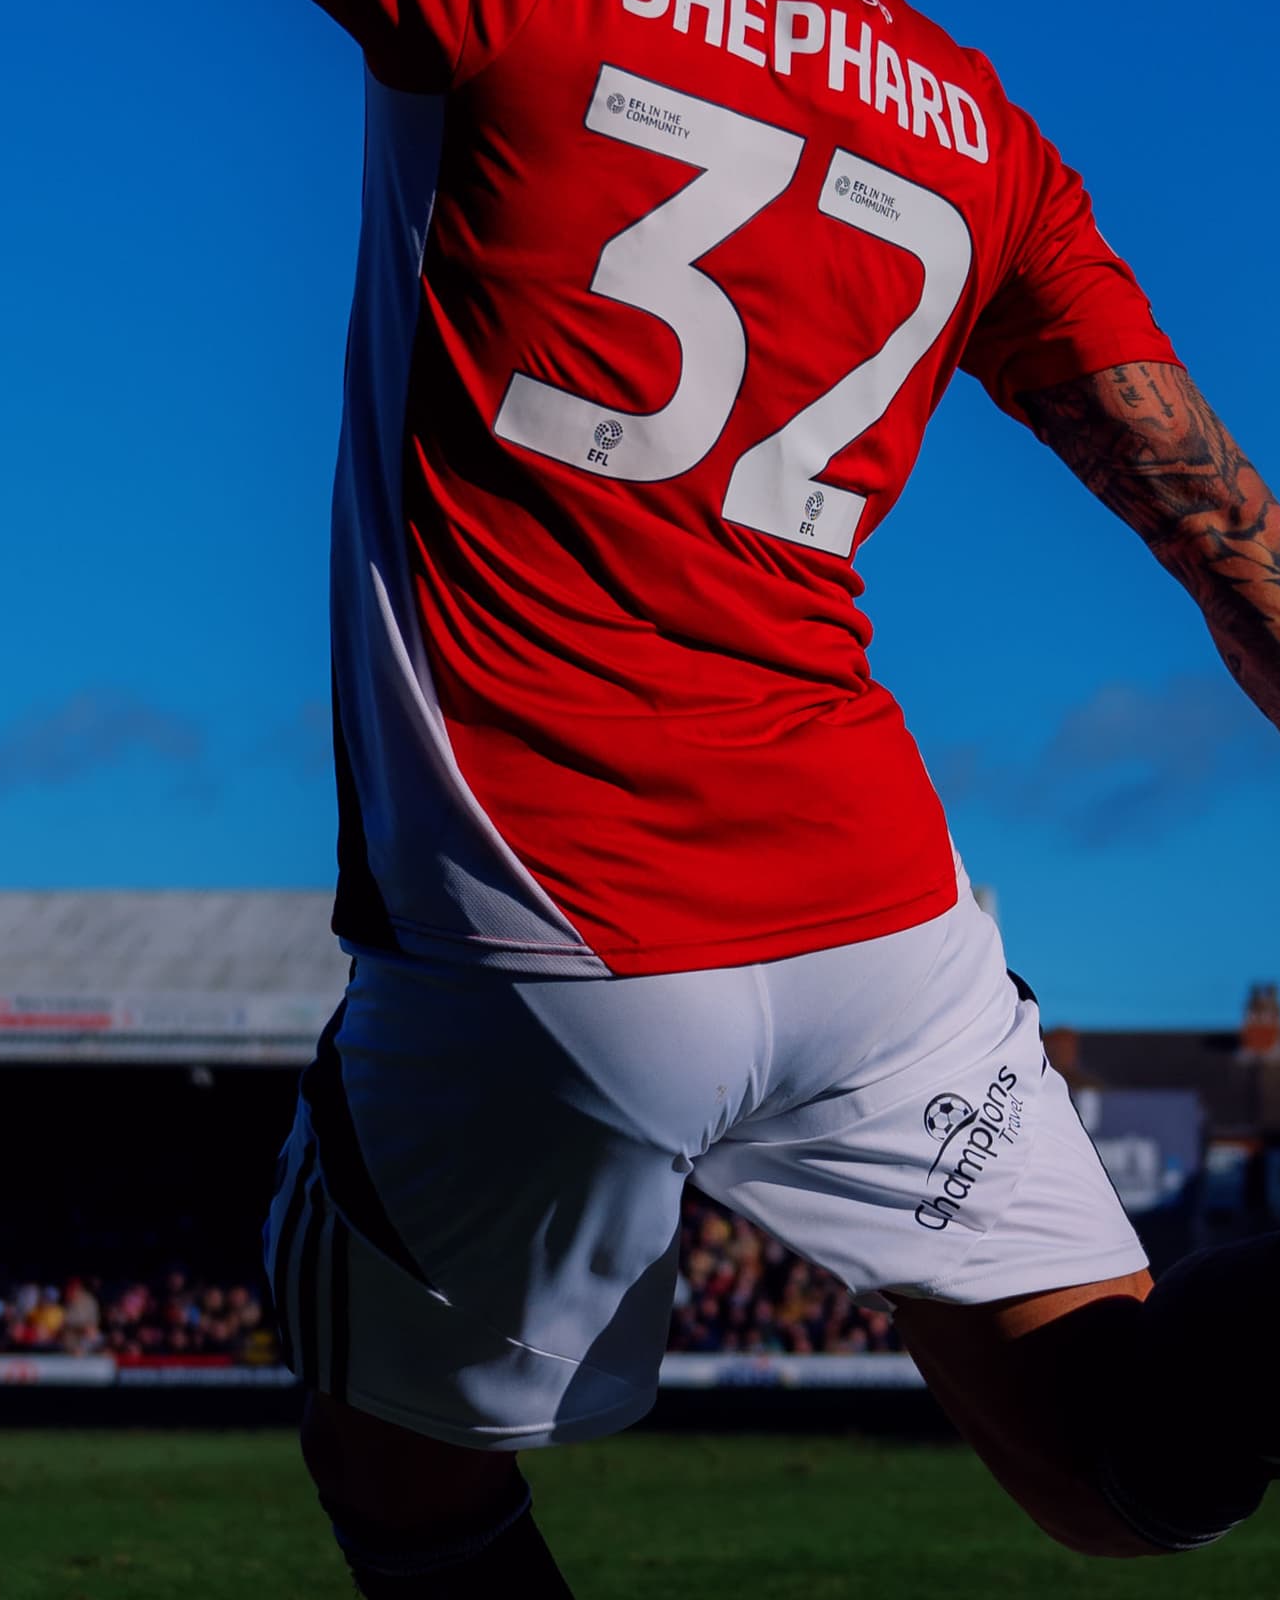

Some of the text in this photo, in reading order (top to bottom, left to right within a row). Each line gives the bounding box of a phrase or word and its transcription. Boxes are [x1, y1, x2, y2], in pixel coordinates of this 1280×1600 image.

[626, 109, 690, 139] COMMUNITY
[628, 98, 682, 125] EFL IN THE
[850, 191, 901, 221] COMMUNITY
[853, 180, 896, 208] EFL IN THE
[492, 62, 974, 560] 32
[587, 447, 608, 467] EFL
[799, 521, 815, 537] EFL
[998, 1092, 1024, 1145] Travel
[915, 1065, 1017, 1230] Champions
